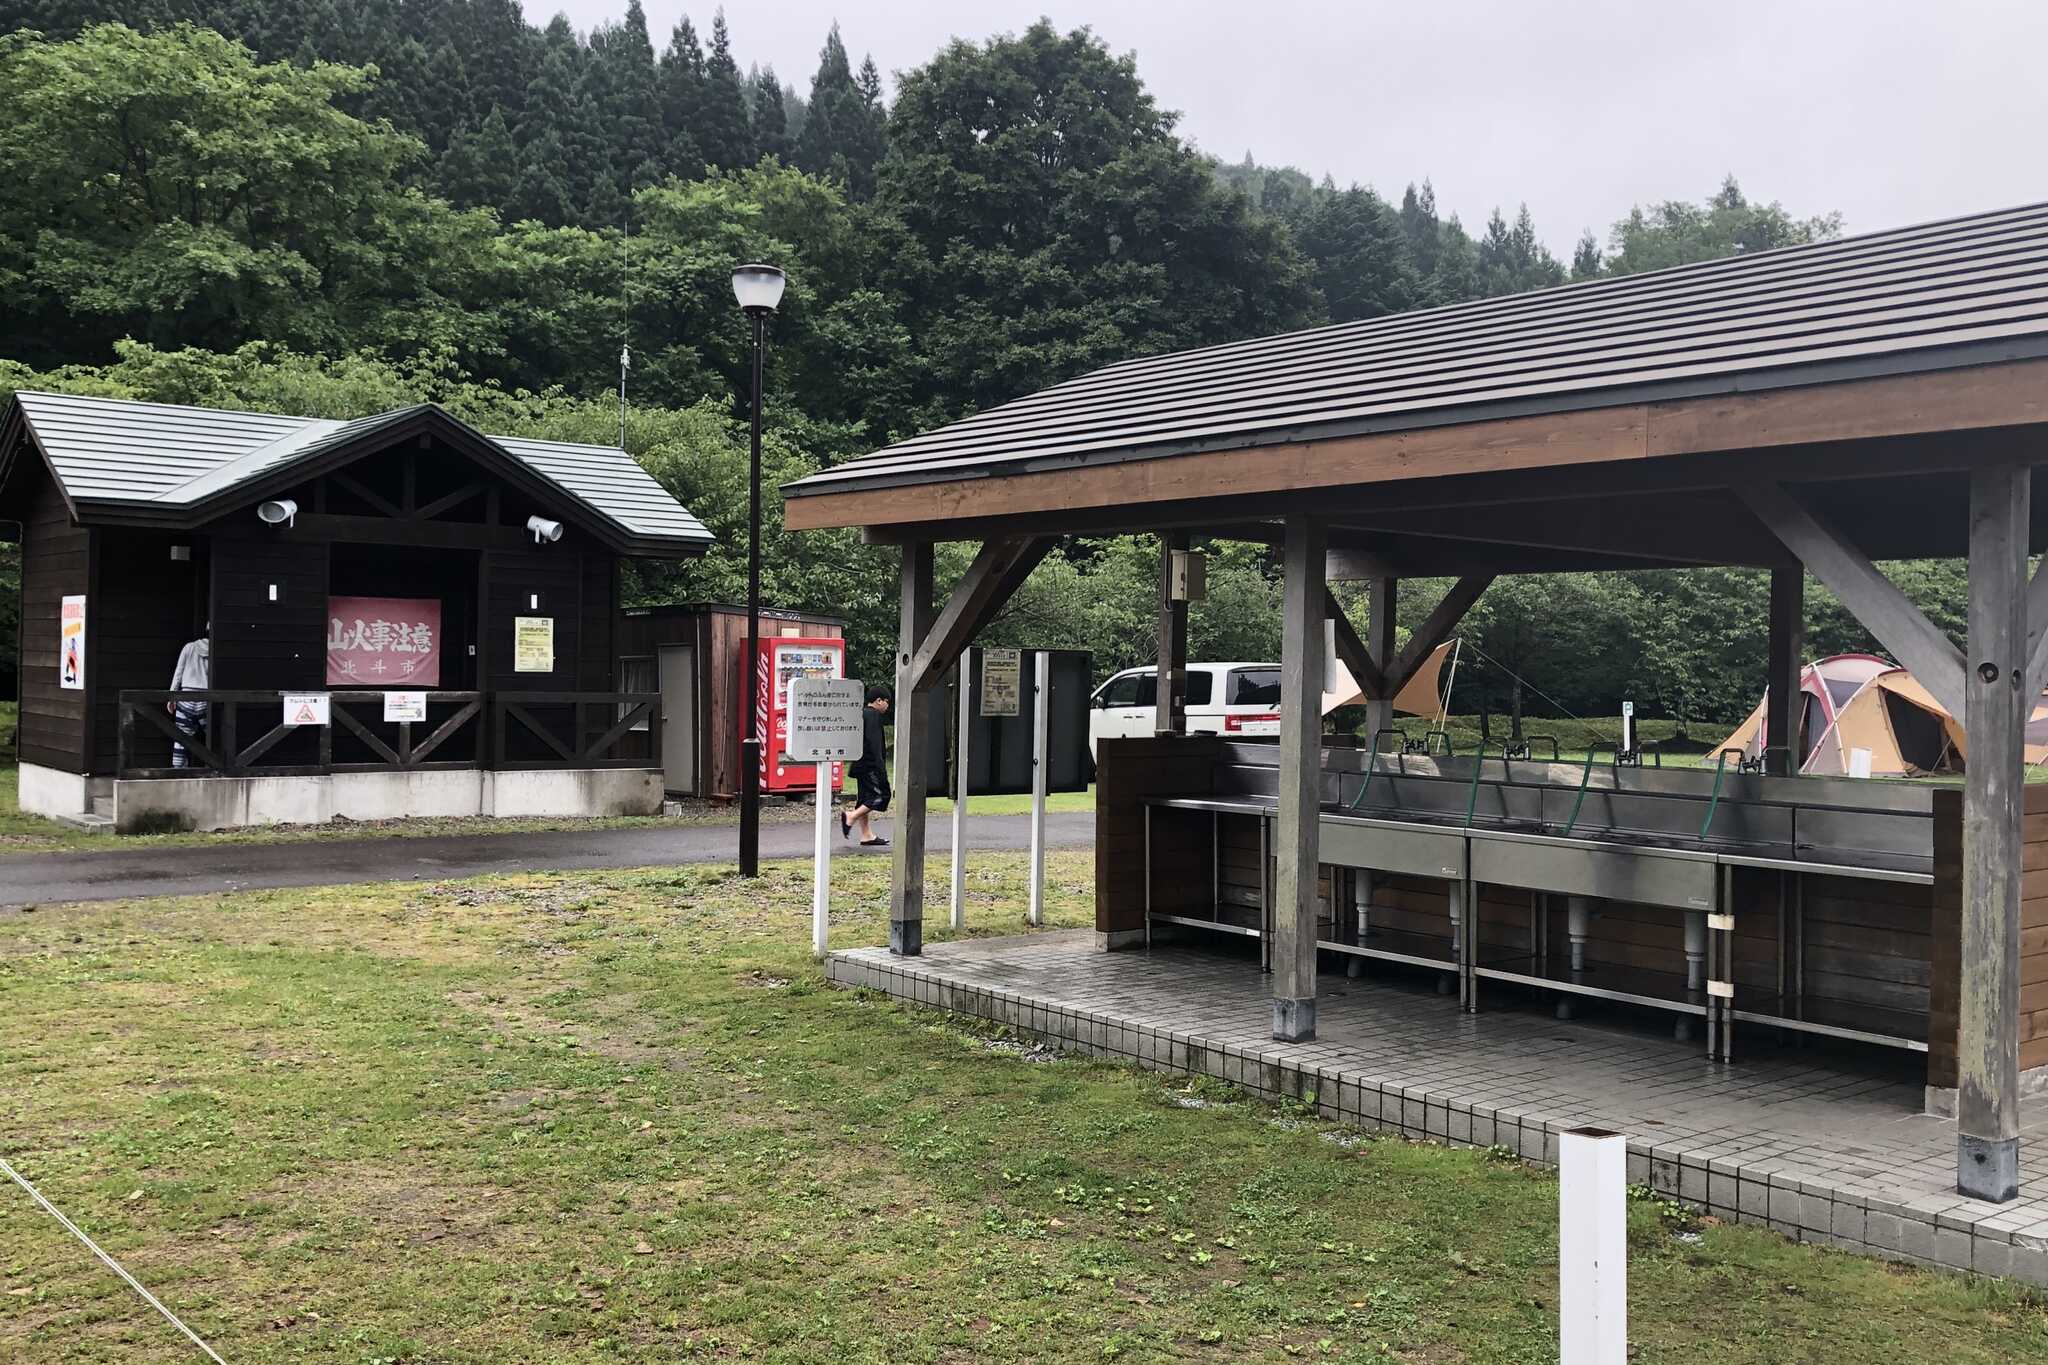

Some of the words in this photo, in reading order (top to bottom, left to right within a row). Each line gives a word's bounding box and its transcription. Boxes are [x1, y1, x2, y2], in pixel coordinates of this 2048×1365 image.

[327, 618, 433, 653] 山火事注意
[340, 659, 416, 675] 北斗市
